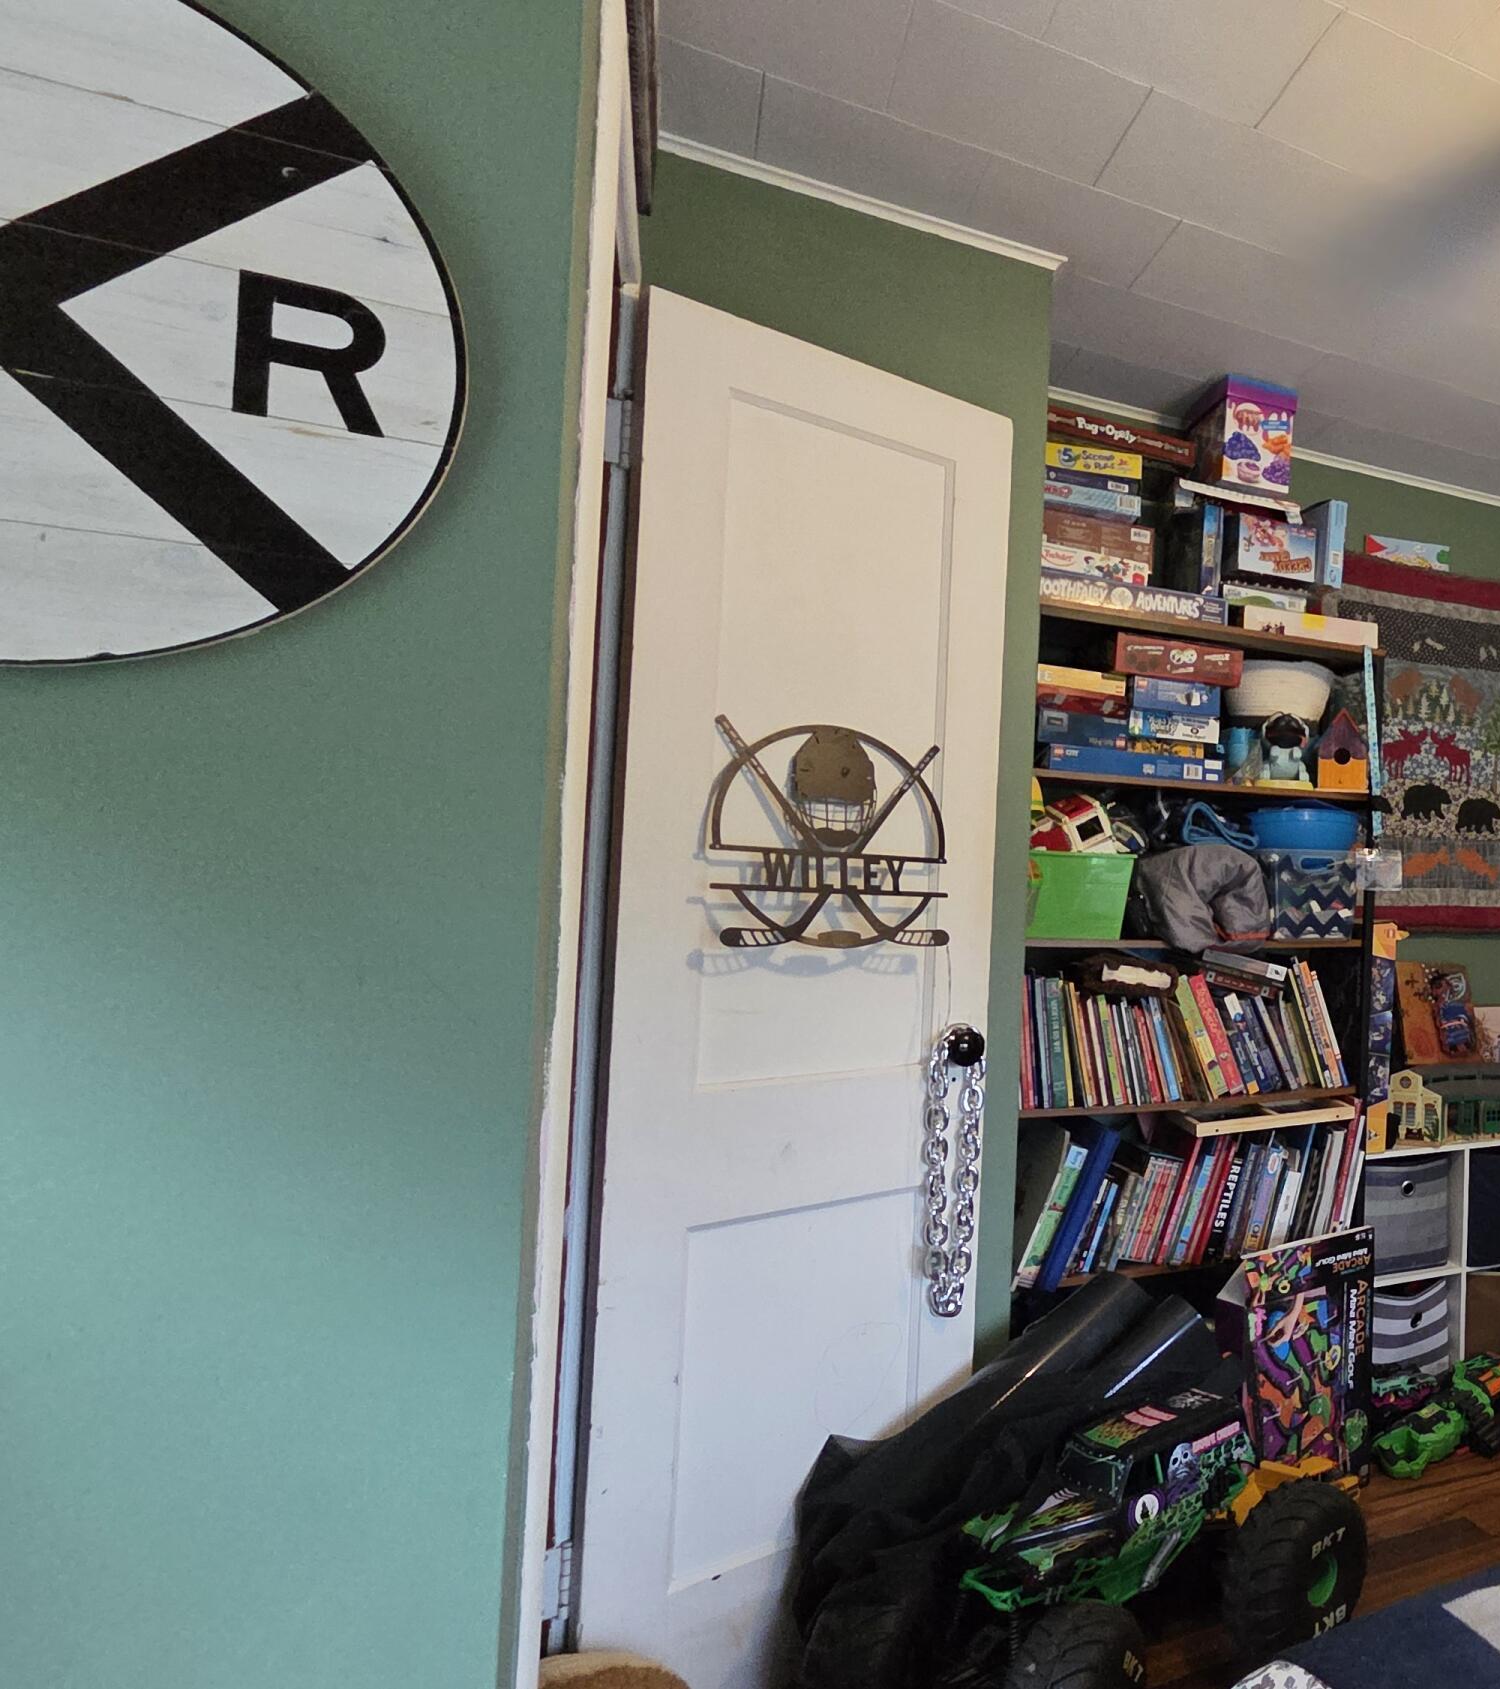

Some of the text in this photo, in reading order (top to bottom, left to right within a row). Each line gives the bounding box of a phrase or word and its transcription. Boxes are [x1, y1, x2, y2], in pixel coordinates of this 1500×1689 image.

[232, 269, 386, 438] R
[761, 849, 906, 893] WILLEY
[1214, 1164, 1242, 1228] REPTILES
[1355, 1279, 1368, 1356] ARCADE
[1311, 1526, 1346, 1560] BKT
